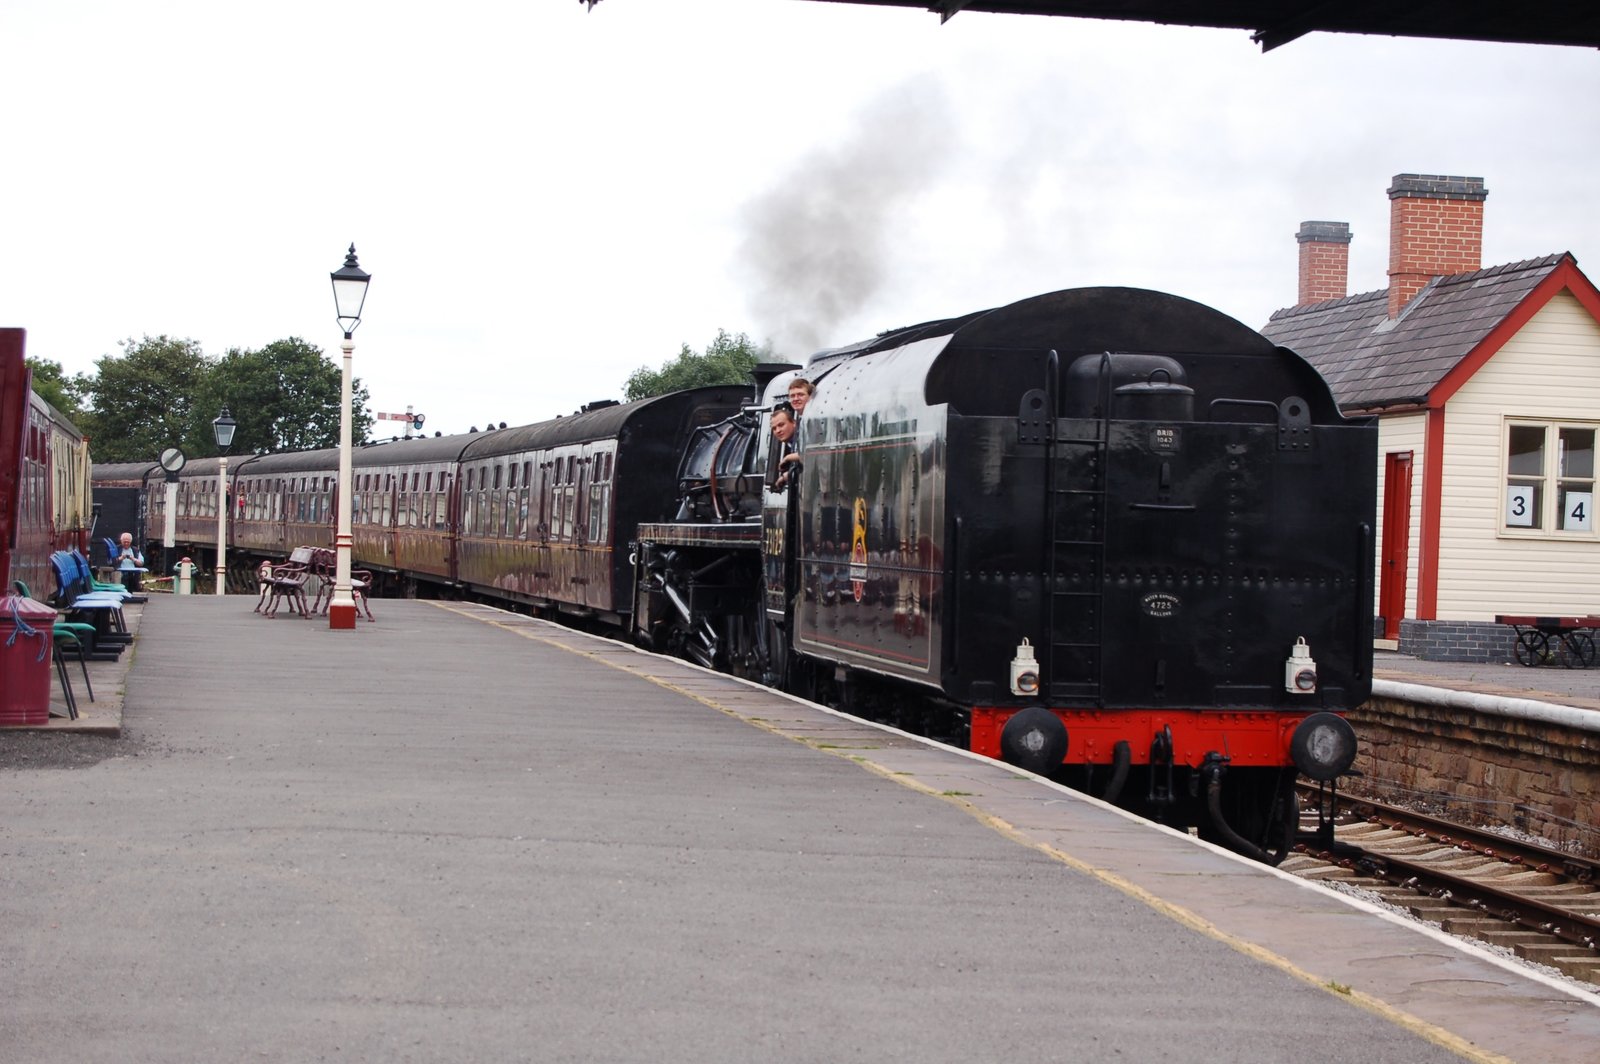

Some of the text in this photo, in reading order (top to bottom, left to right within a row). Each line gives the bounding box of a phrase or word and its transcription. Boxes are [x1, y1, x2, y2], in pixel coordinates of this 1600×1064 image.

[1512, 495, 1526, 517] 3
[1571, 501, 1586, 522] 4
[1150, 601, 1172, 609] 4725
